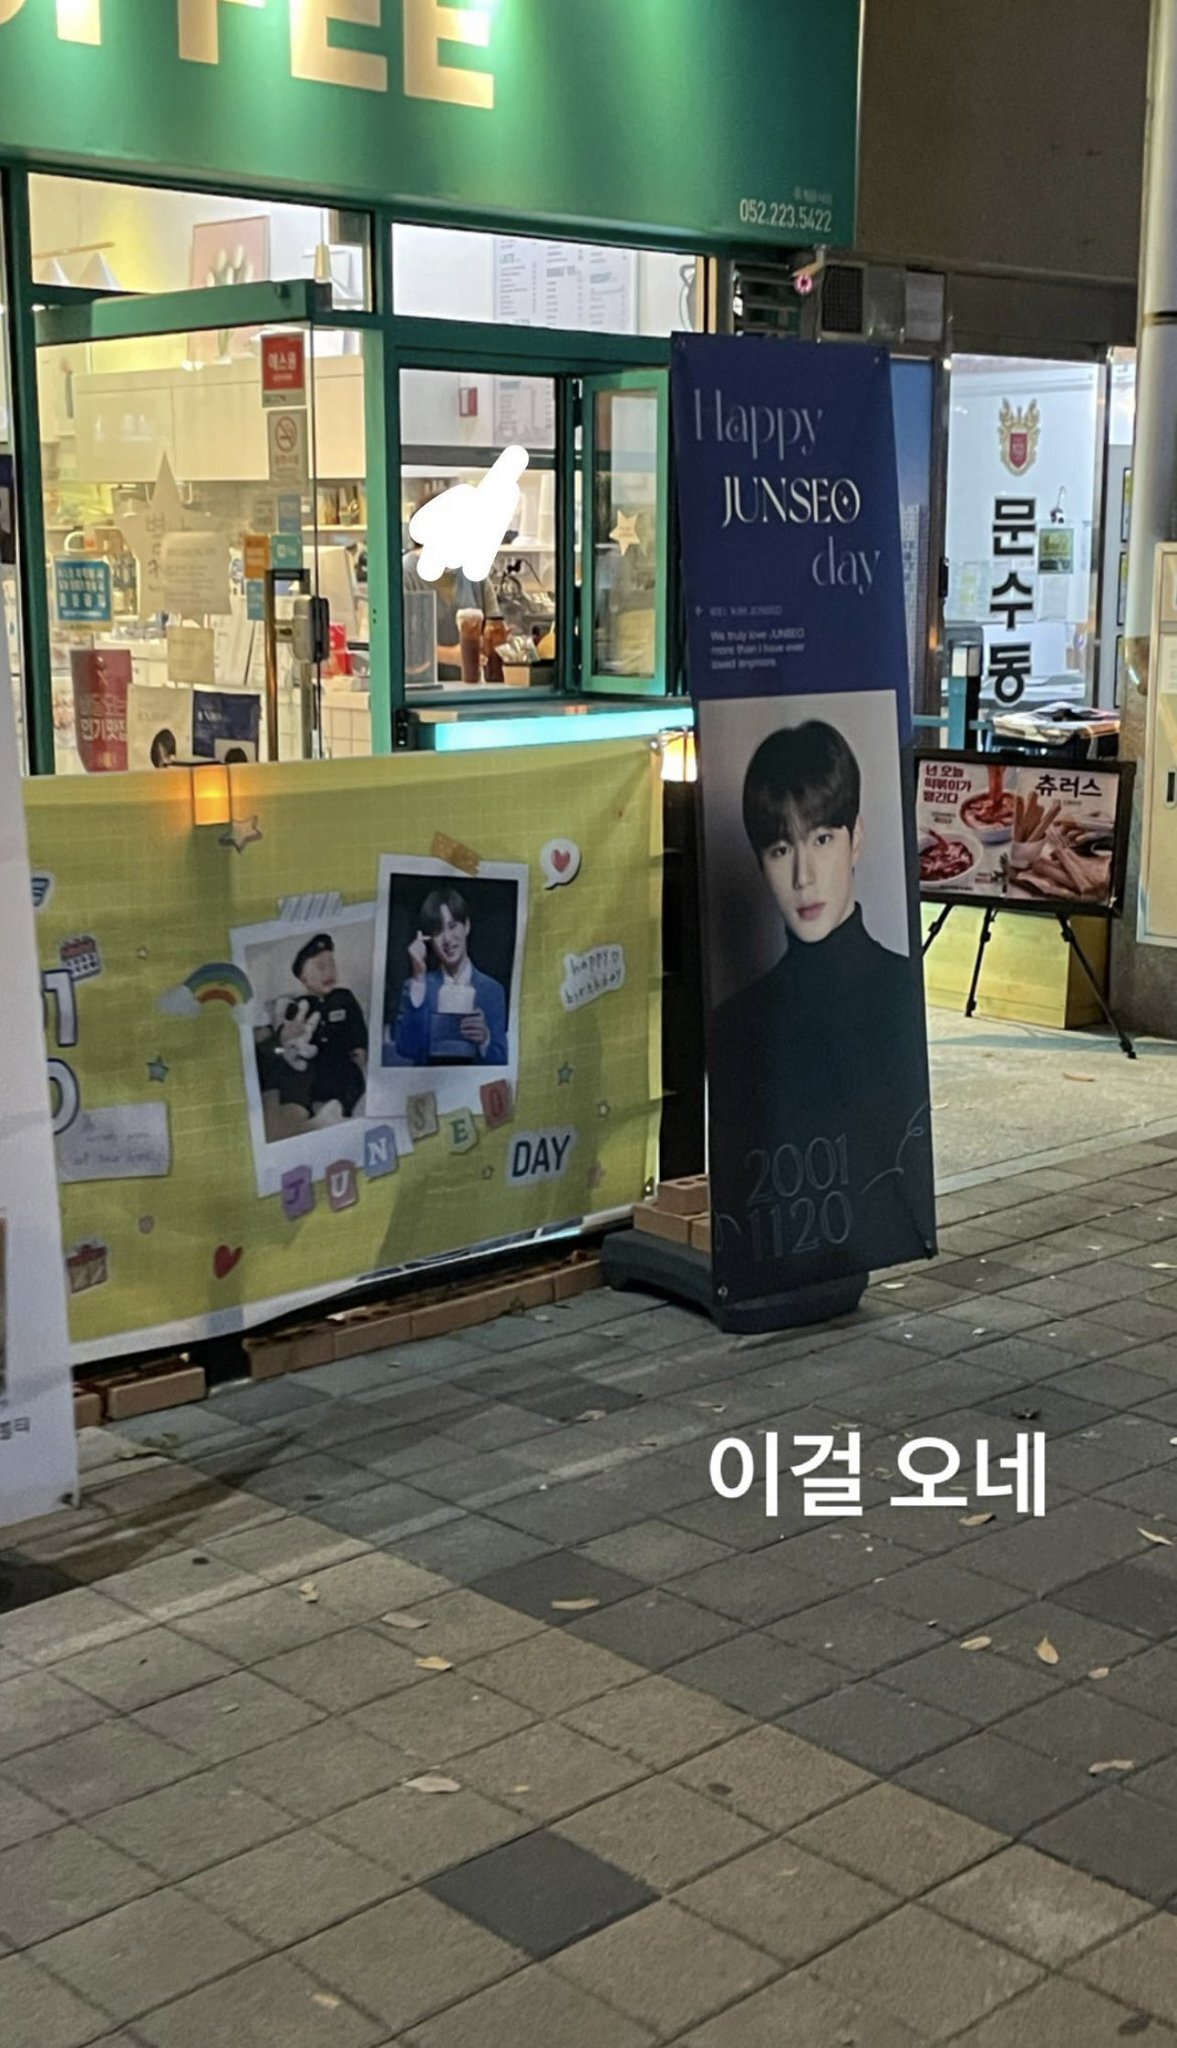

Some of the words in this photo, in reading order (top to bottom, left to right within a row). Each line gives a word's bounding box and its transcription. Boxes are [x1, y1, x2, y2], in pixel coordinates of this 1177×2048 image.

[740, 198, 832, 233] 052.223.5422
[694, 388, 824, 461] Happy
[722, 476, 861, 528] JUNSEO
[811, 535, 881, 596] day
[988, 497, 1037, 705] 문수동
[1035, 774, 1102, 799] 츄러스
[564, 969, 622, 1004] birthday
[569, 950, 607, 977] happy
[41, 968, 79, 1048] 1
[284, 1085, 501, 1206] JUNSEO
[511, 1133, 571, 1178] DAY
[746, 1133, 850, 1204] 2001
[750, 1190, 851, 1262] 1120
